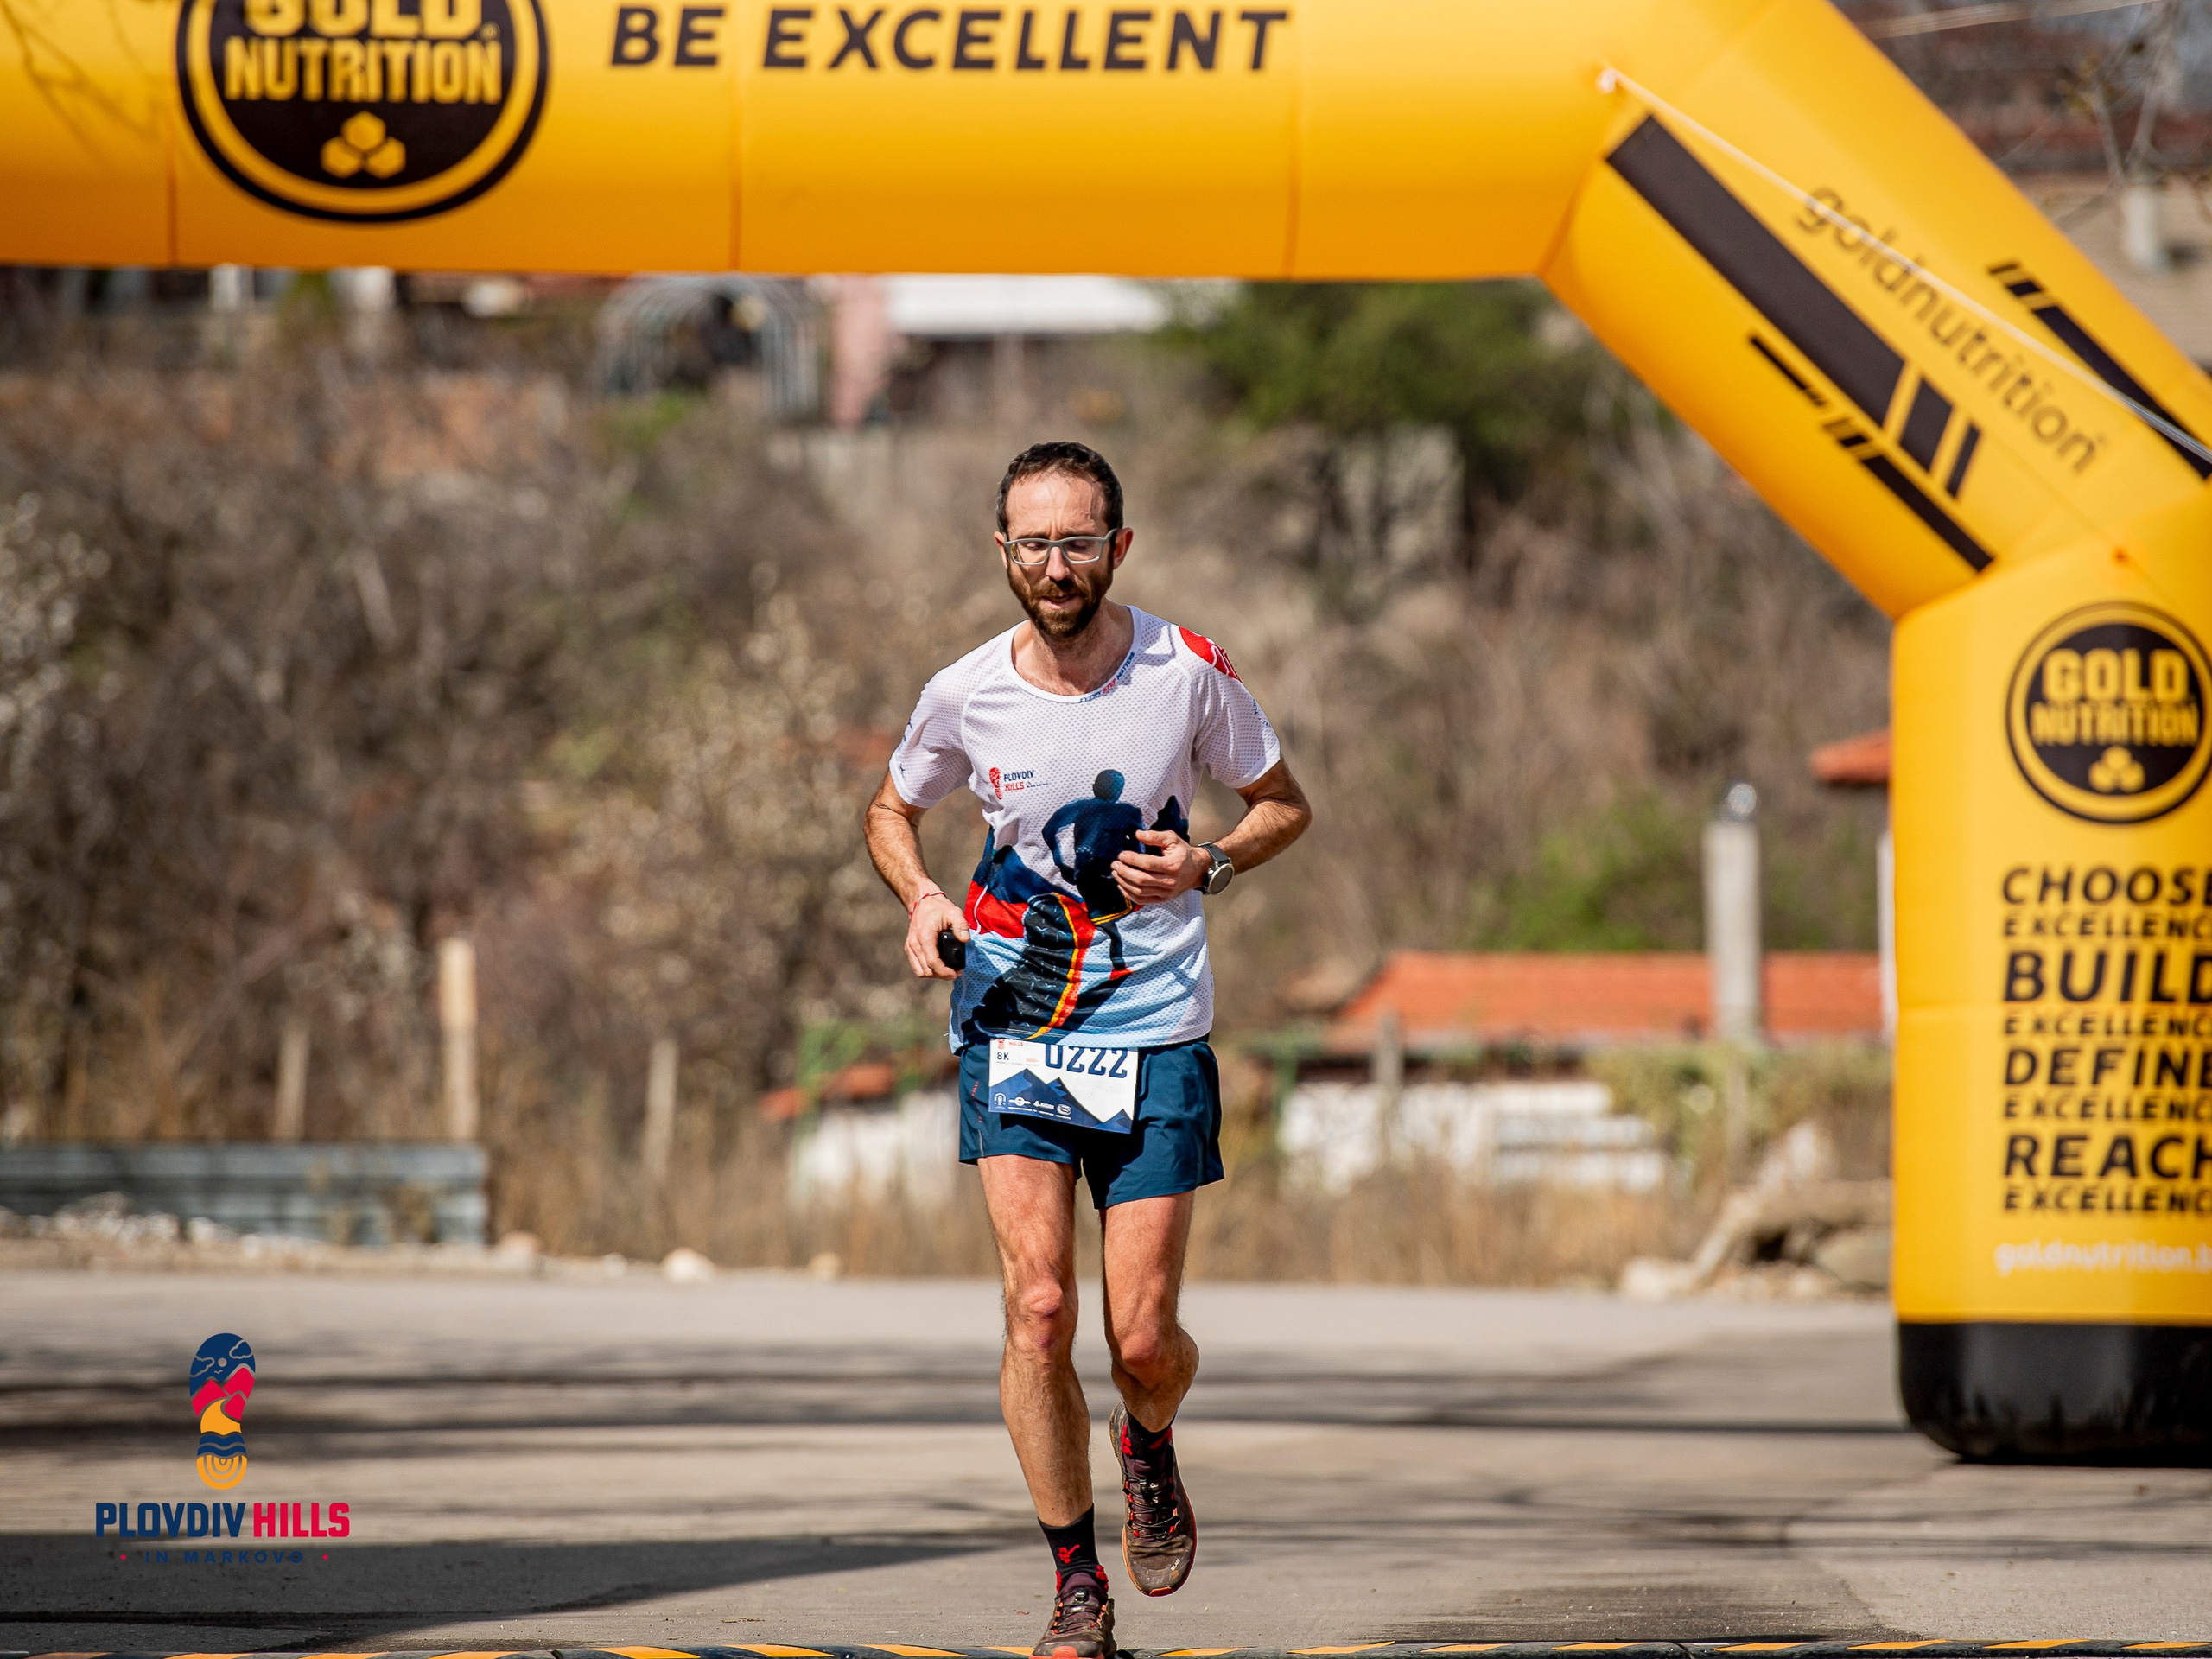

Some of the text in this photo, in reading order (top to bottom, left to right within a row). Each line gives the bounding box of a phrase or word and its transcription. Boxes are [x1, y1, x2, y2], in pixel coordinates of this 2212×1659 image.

[610, 7, 1287, 71] BE EXCELLENT
[225, 36, 502, 103] NUTRITION
[1795, 187, 2100, 475] goldnutrition
[2043, 647, 2190, 702] GOLD
[2031, 701, 2199, 746] NUTRITION
[2003, 951, 2212, 1003] BUILD
[996, 1052, 1009, 1061] 8K
[1045, 1043, 1128, 1079] 0222
